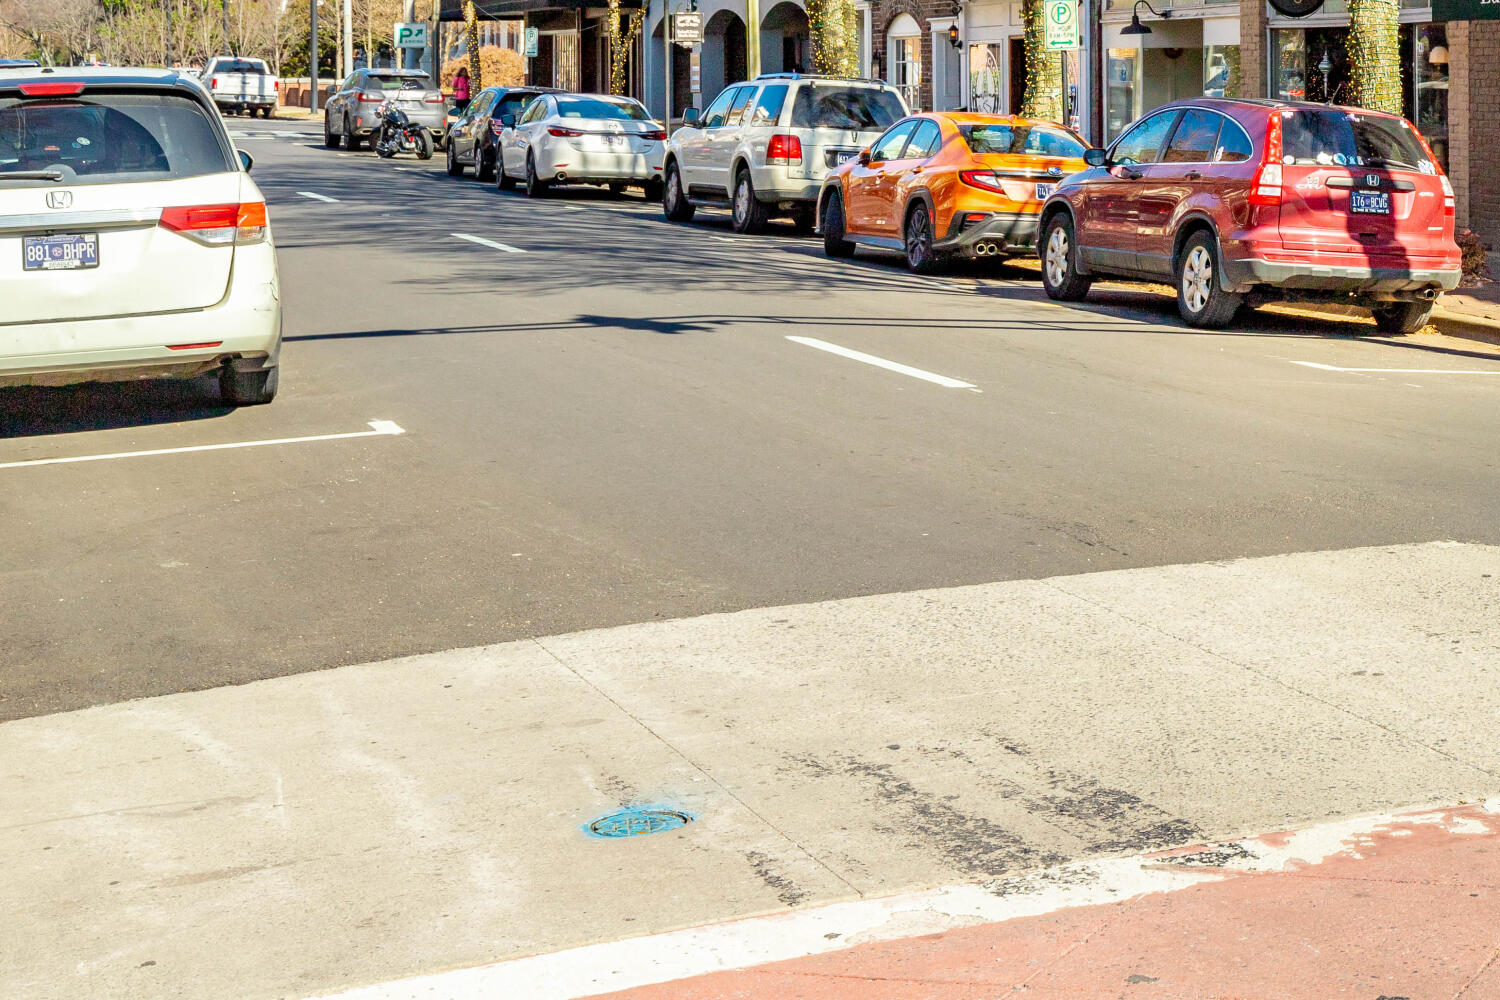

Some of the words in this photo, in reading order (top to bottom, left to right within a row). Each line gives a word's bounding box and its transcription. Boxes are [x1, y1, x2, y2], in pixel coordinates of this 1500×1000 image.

[1057, 6, 1066, 21] P
[1352, 195, 1366, 208] 176
[27, 245, 52, 261] 881
[63, 242, 95, 260] BHPR
